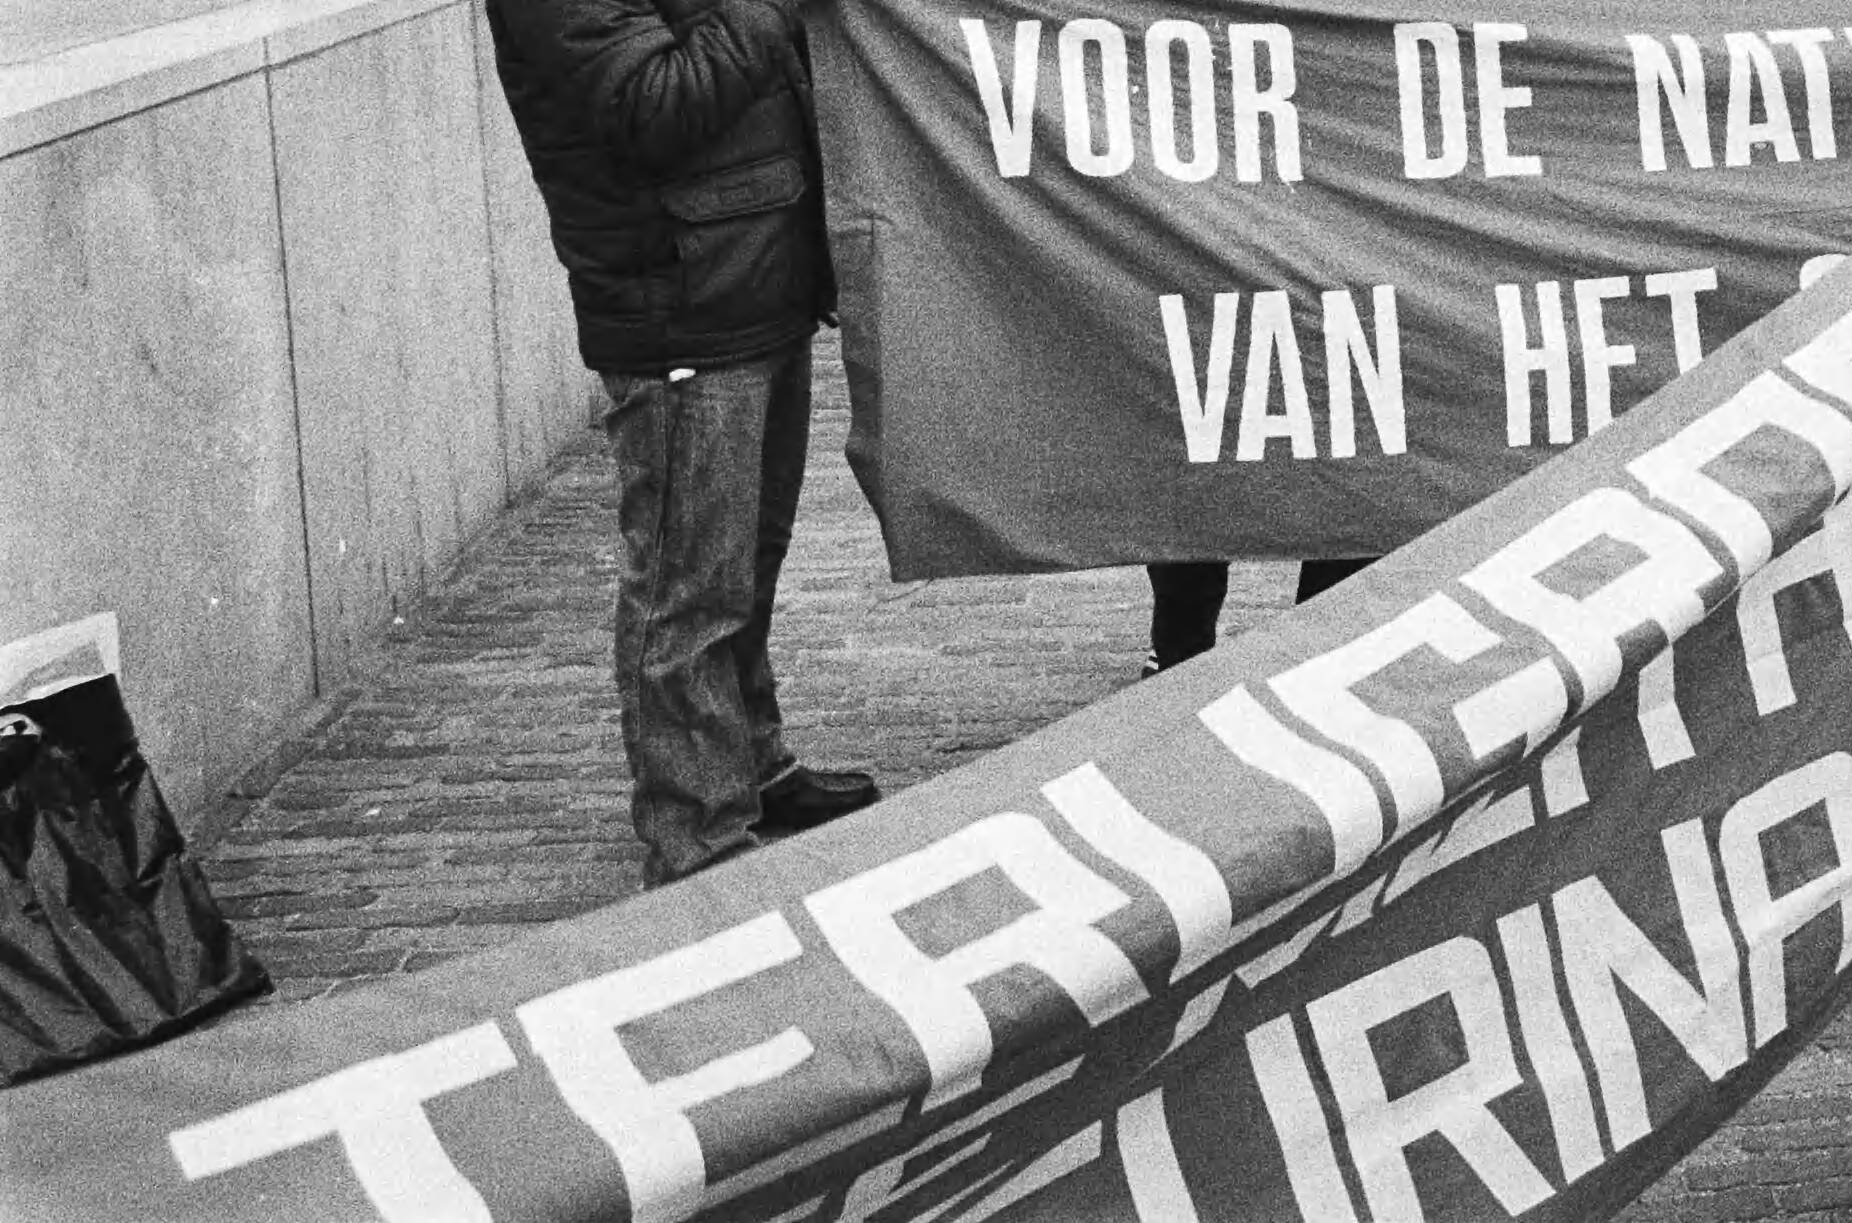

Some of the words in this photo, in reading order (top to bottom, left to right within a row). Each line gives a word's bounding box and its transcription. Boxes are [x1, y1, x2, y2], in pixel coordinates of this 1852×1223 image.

[958, 17, 1306, 182] VOOR
[1394, 20, 1544, 181] DE
[1159, 284, 1407, 463] VAN
[1495, 268, 1718, 446] HET
